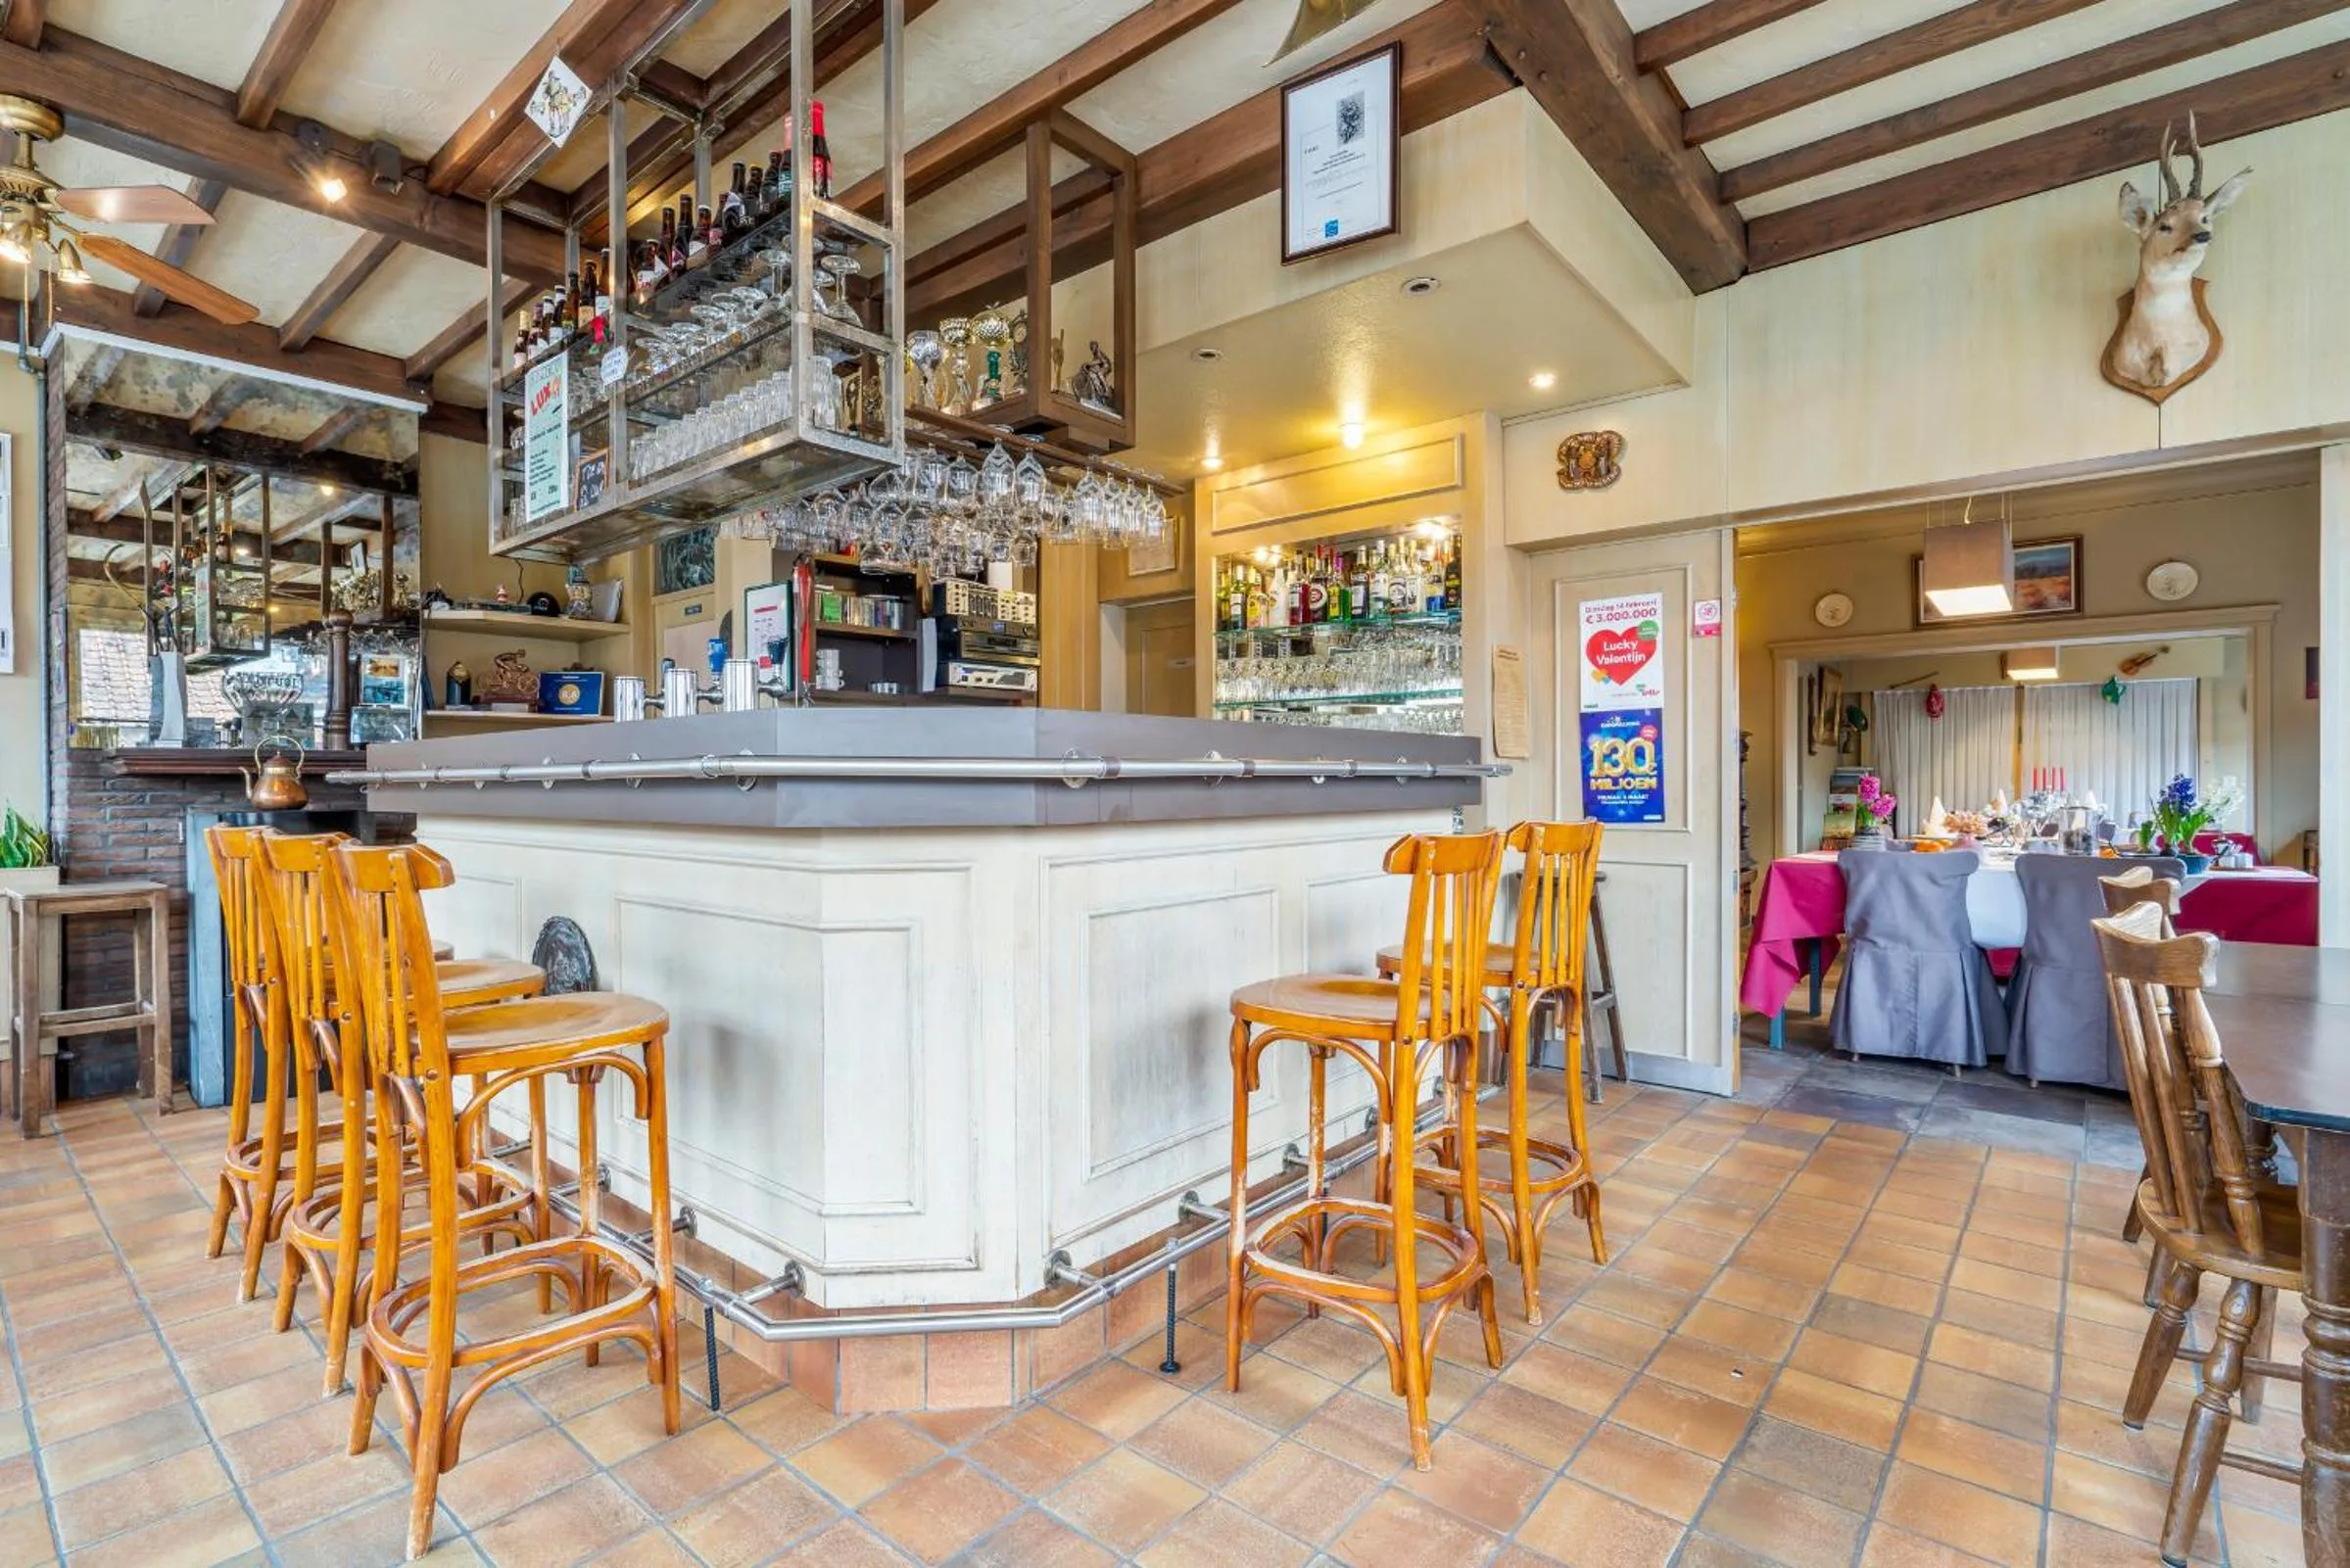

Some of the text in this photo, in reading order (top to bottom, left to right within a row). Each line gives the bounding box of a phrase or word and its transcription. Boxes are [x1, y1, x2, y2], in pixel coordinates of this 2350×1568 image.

[1596, 607, 1657, 623] 3.000.000
[1604, 640, 1639, 652] Lucky
[1596, 651, 1646, 665] Valentijn
[1589, 736, 1655, 777] 130
[1590, 777, 1657, 790] MILJOEN
